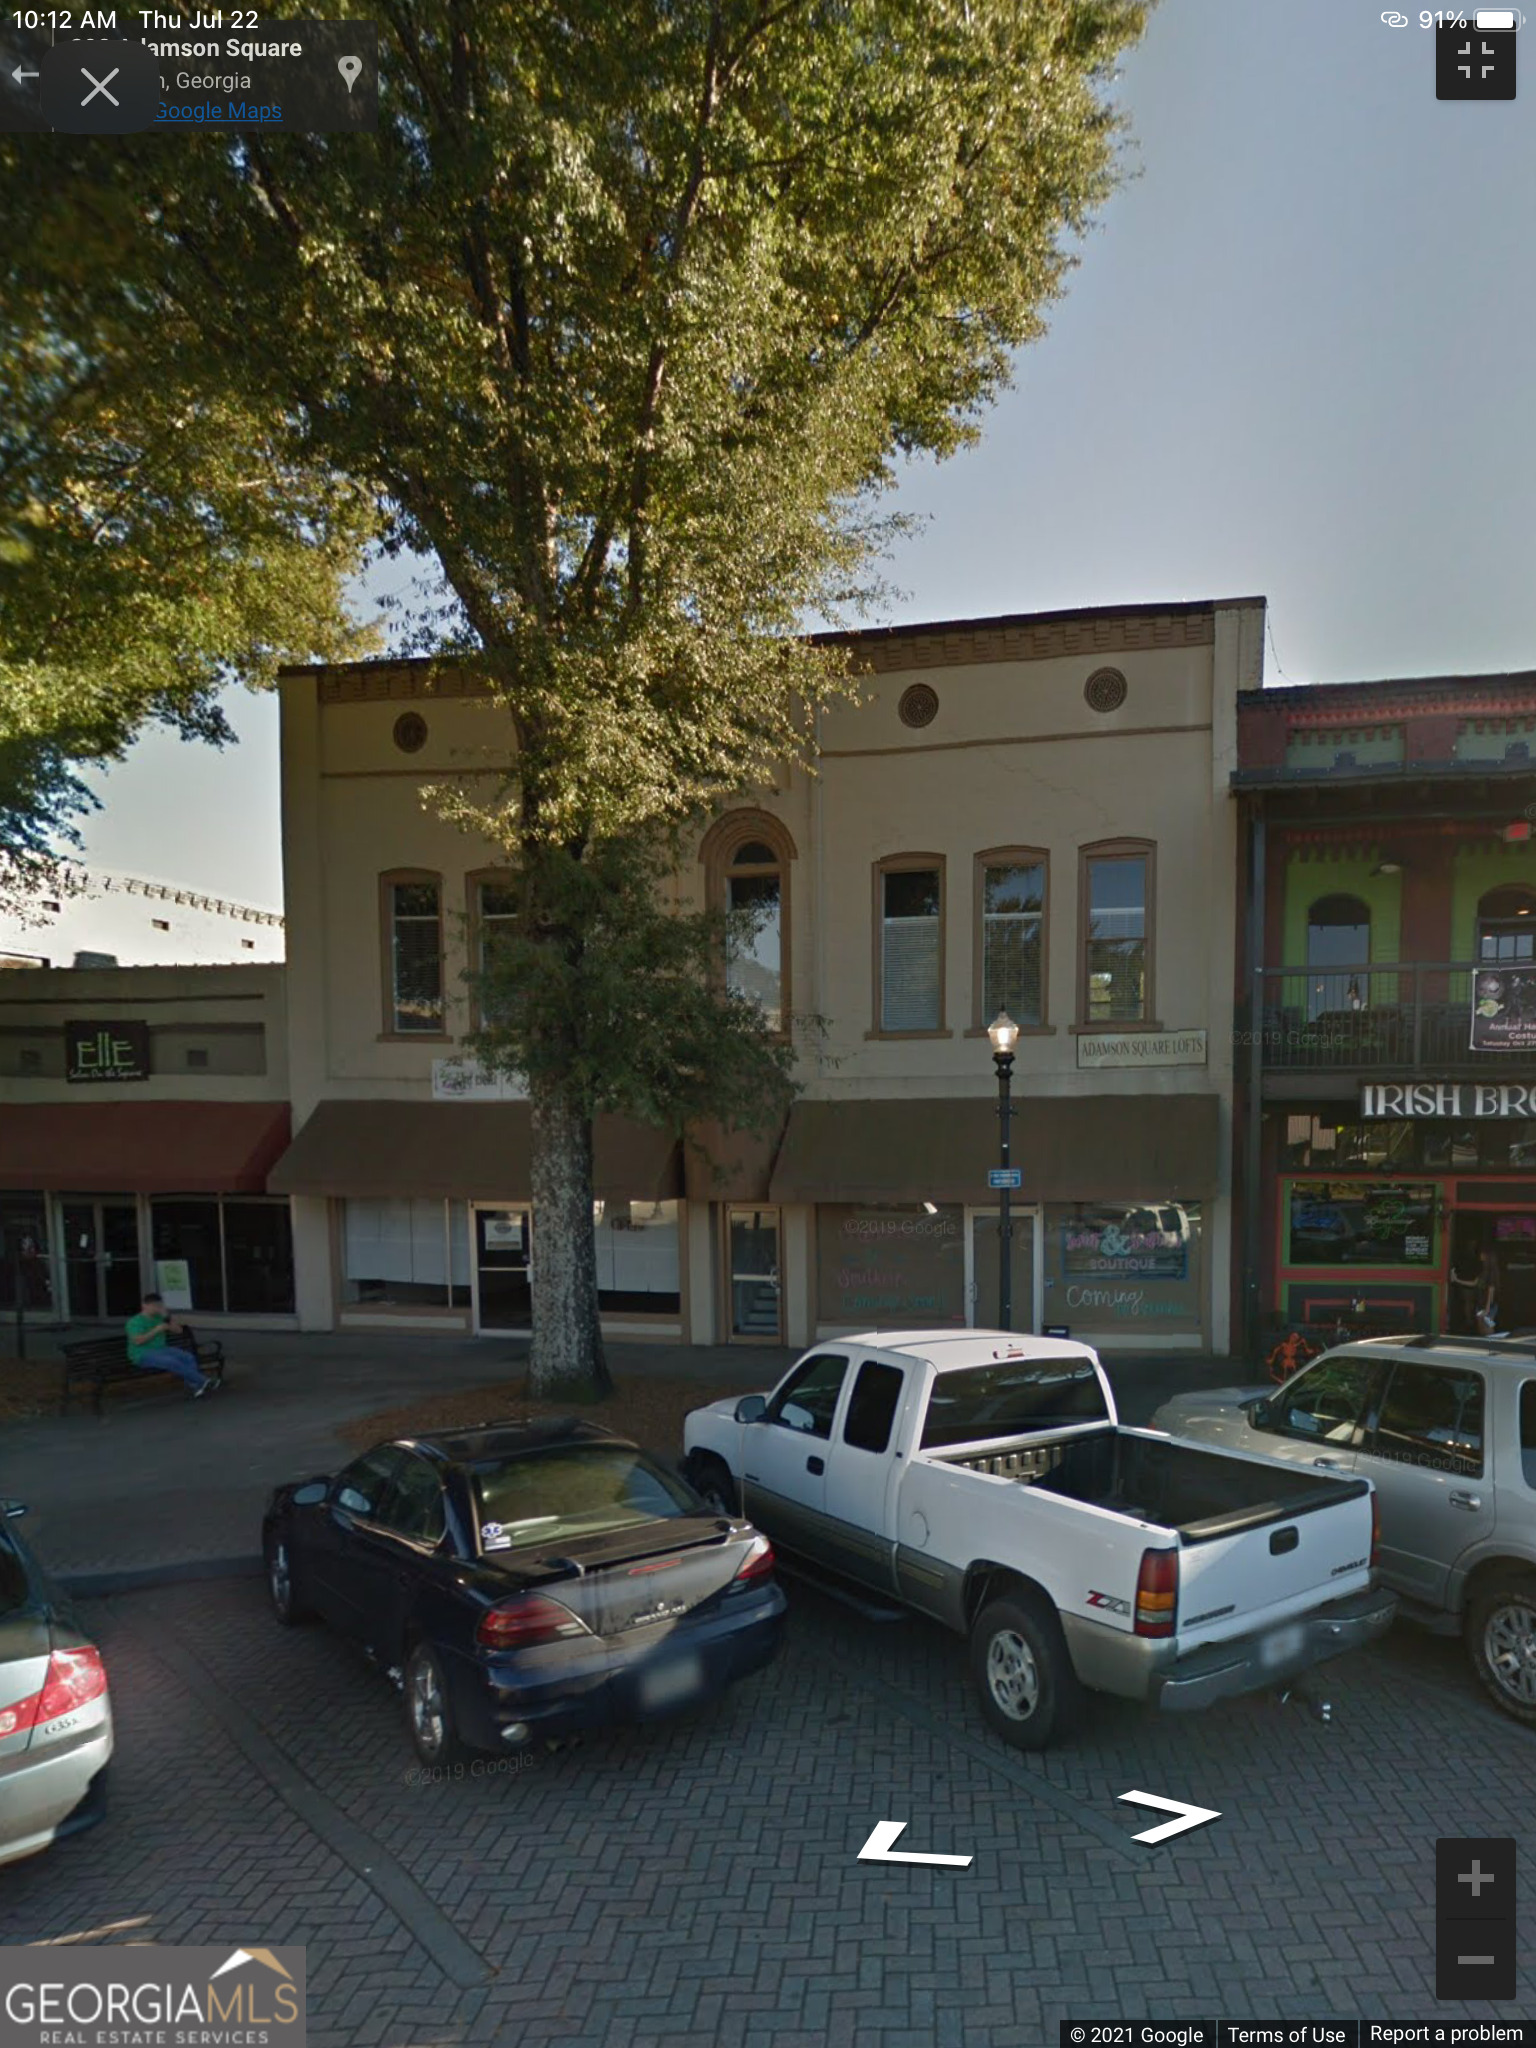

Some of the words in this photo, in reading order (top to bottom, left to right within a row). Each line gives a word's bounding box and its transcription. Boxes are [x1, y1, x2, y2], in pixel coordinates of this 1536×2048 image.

[1082, 1041, 1130, 1056] ADAMSON
[1132, 1040, 1169, 1055] SQUARE
[1173, 1038, 1203, 1054] LOFTS
[1361, 1083, 1463, 1117] IRISH
[1089, 1259, 1157, 1271] BOUTIQUE
[1067, 1285, 1144, 1315] Coming
